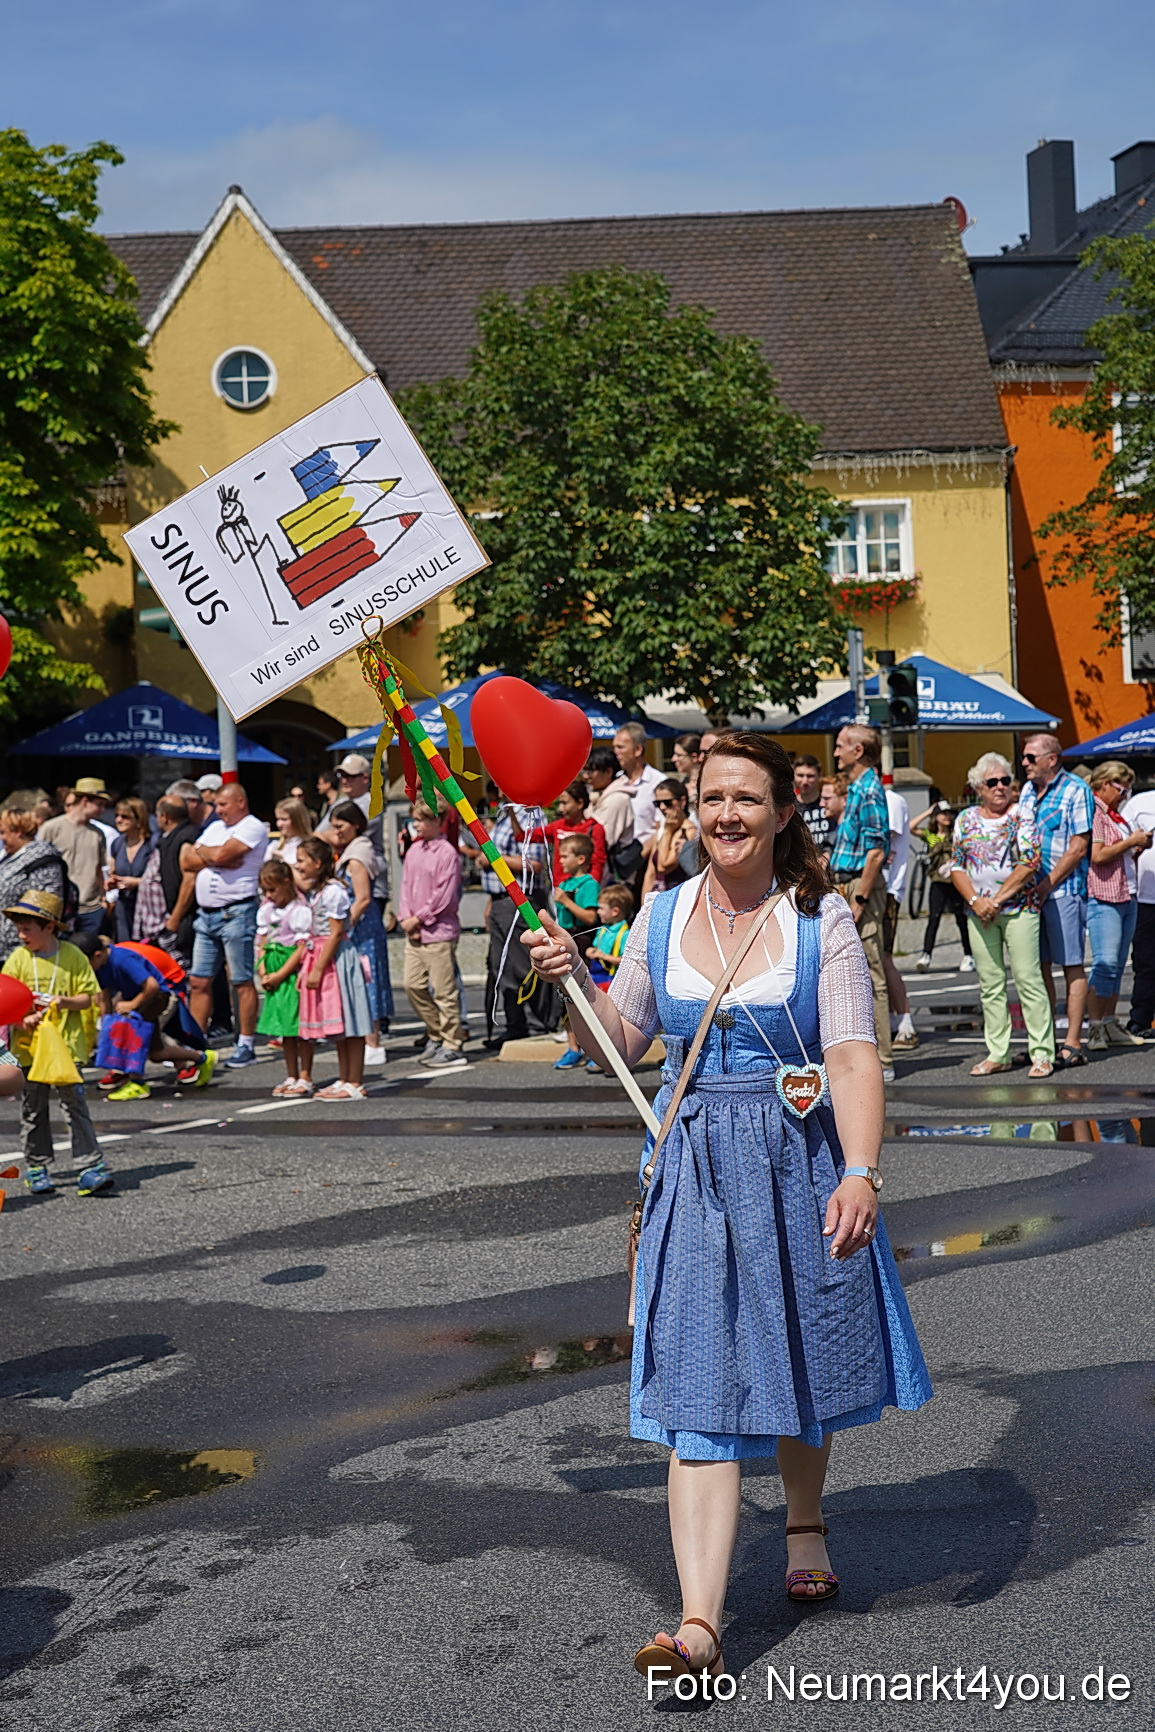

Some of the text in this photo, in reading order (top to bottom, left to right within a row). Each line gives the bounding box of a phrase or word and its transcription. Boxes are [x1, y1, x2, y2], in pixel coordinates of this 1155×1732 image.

[150, 522, 230, 627] SINUS
[250, 545, 462, 686] Wir sind SINUSSCHULE
[917, 700, 981, 712] BRÄU
